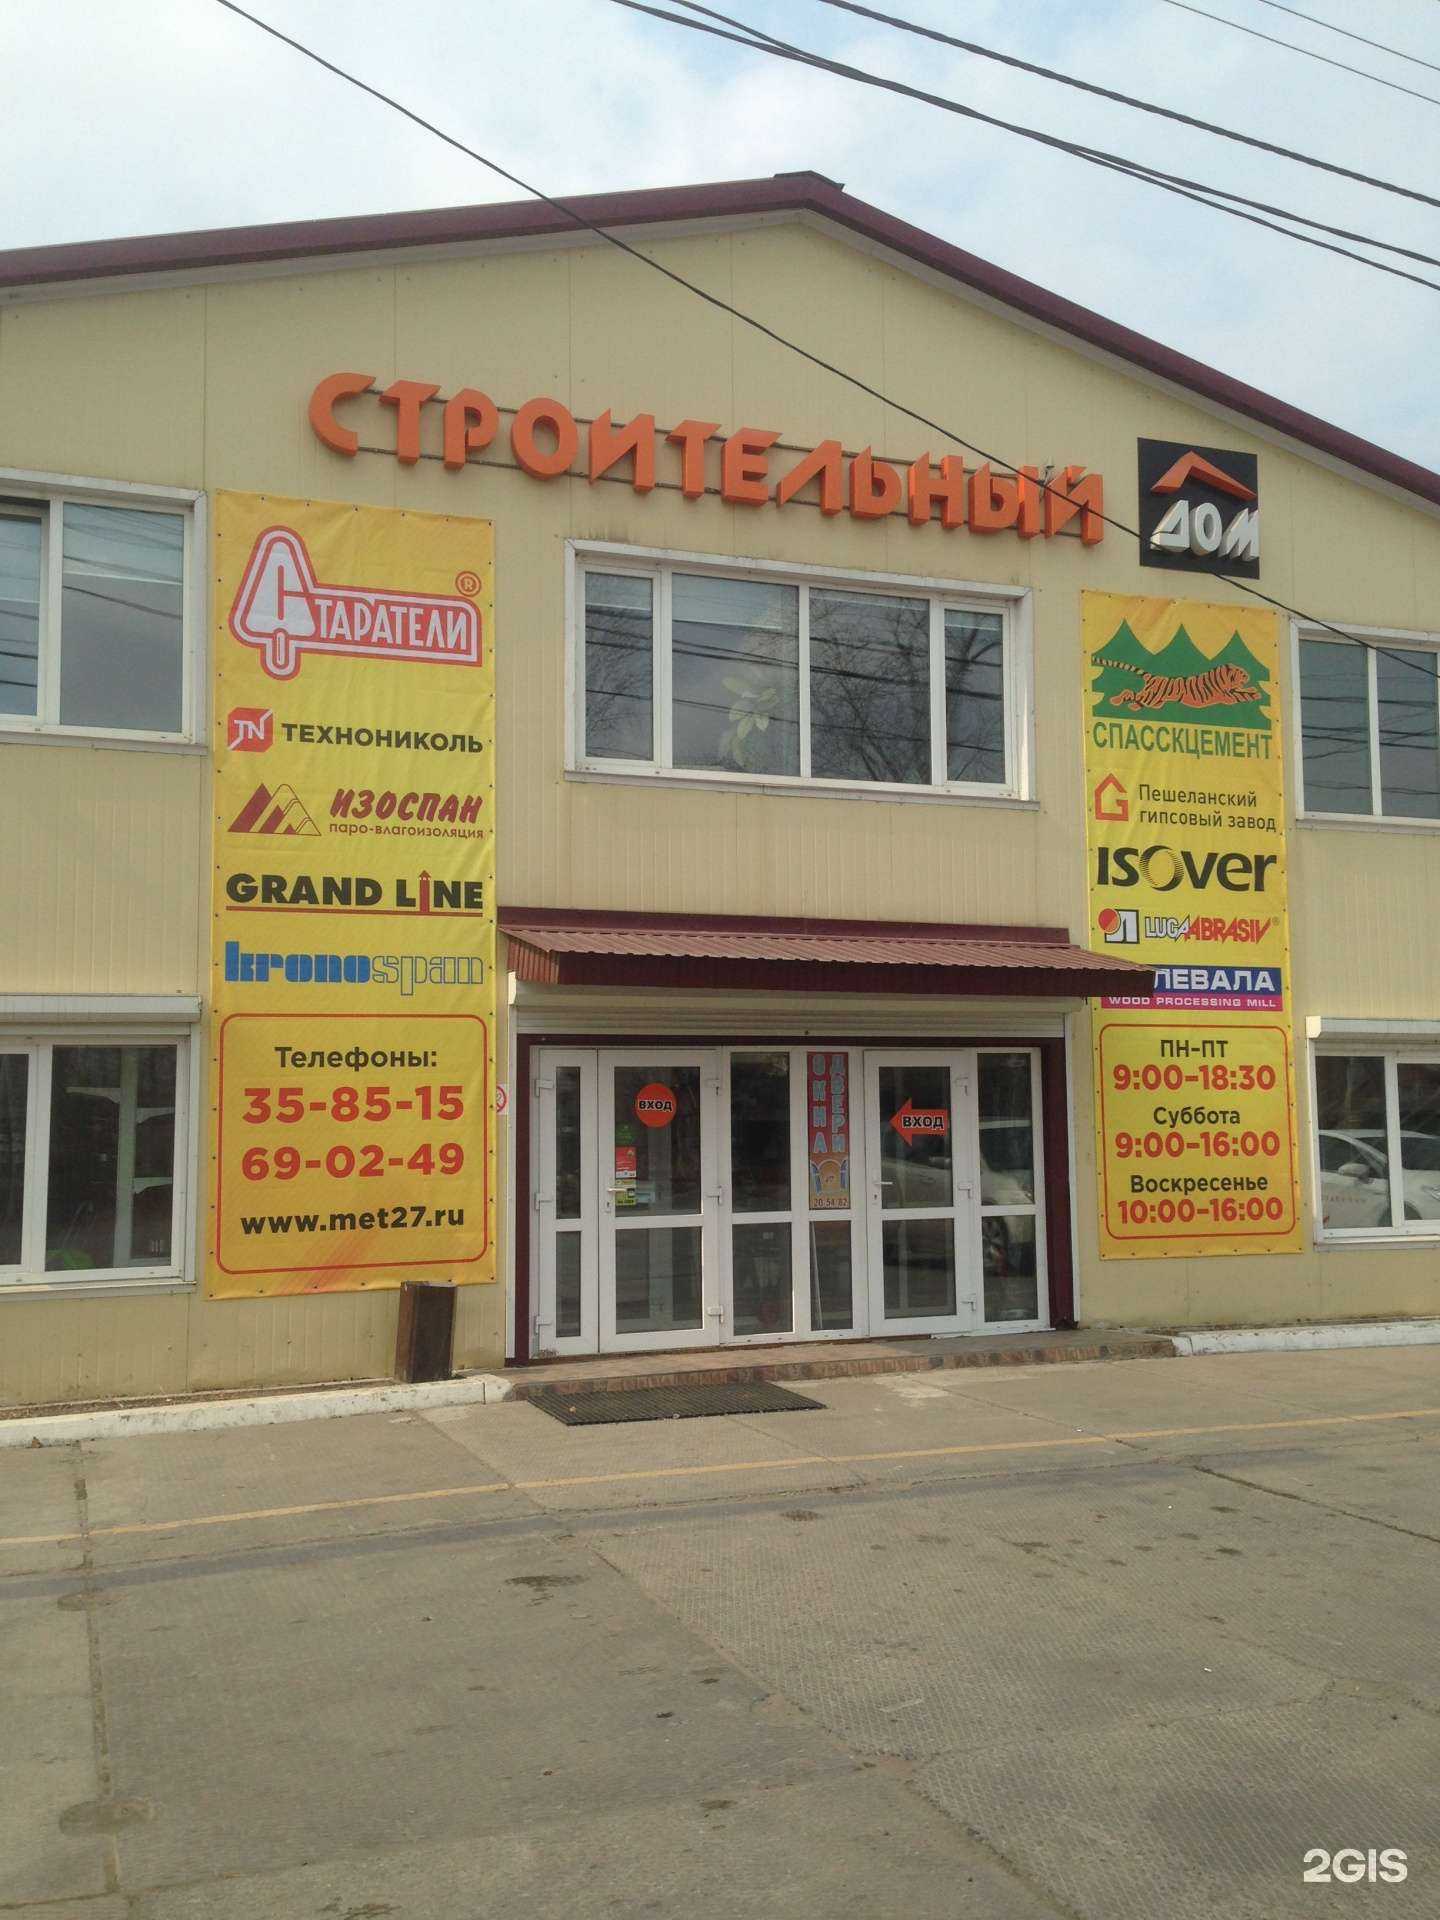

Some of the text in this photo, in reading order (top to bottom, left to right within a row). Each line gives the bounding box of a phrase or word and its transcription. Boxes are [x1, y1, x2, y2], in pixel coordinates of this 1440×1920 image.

[308, 372, 1104, 545] СТРОИТЕЛЬНЫЙ
[1150, 499, 1260, 561] ДОМ
[281, 722, 483, 752] ТЕХНОНИКОЛЬ
[1093, 721, 1272, 759] СПАССКЦЕМЕНТ
[329, 788, 484, 824] ИЗОСПАН
[1139, 784, 1257, 807] Пешеланский
[329, 823, 484, 840] паро-влагоизоляция
[1139, 809, 1277, 832] гипсовый завод
[226, 870, 484, 912] GRAND LINE
[225, 941, 484, 996] kronospan
[1153, 968, 1276, 992] ЛЕВАЛА
[1108, 996, 1277, 1008] WOOD PROCESSING MILL
[275, 1046, 437, 1071] Телефоны:
[1160, 1040, 1229, 1058] ПН-ПТ
[1113, 1064, 1277, 1091] 9:00-18:30
[242, 1085, 465, 1124] 35-85-15
[638, 1100, 673, 1112] ВХОД
[1153, 1107, 1241, 1128] Суббота
[902, 1115, 944, 1130] ВХОД
[1115, 1131, 1281, 1158] 9:00-16:00
[242, 1143, 465, 1181] 69-02-49
[1130, 1175, 1268, 1195] Воскресенье
[240, 1206, 465, 1235] www.met27.ru
[1117, 1197, 1284, 1225] 10:00-16:00
